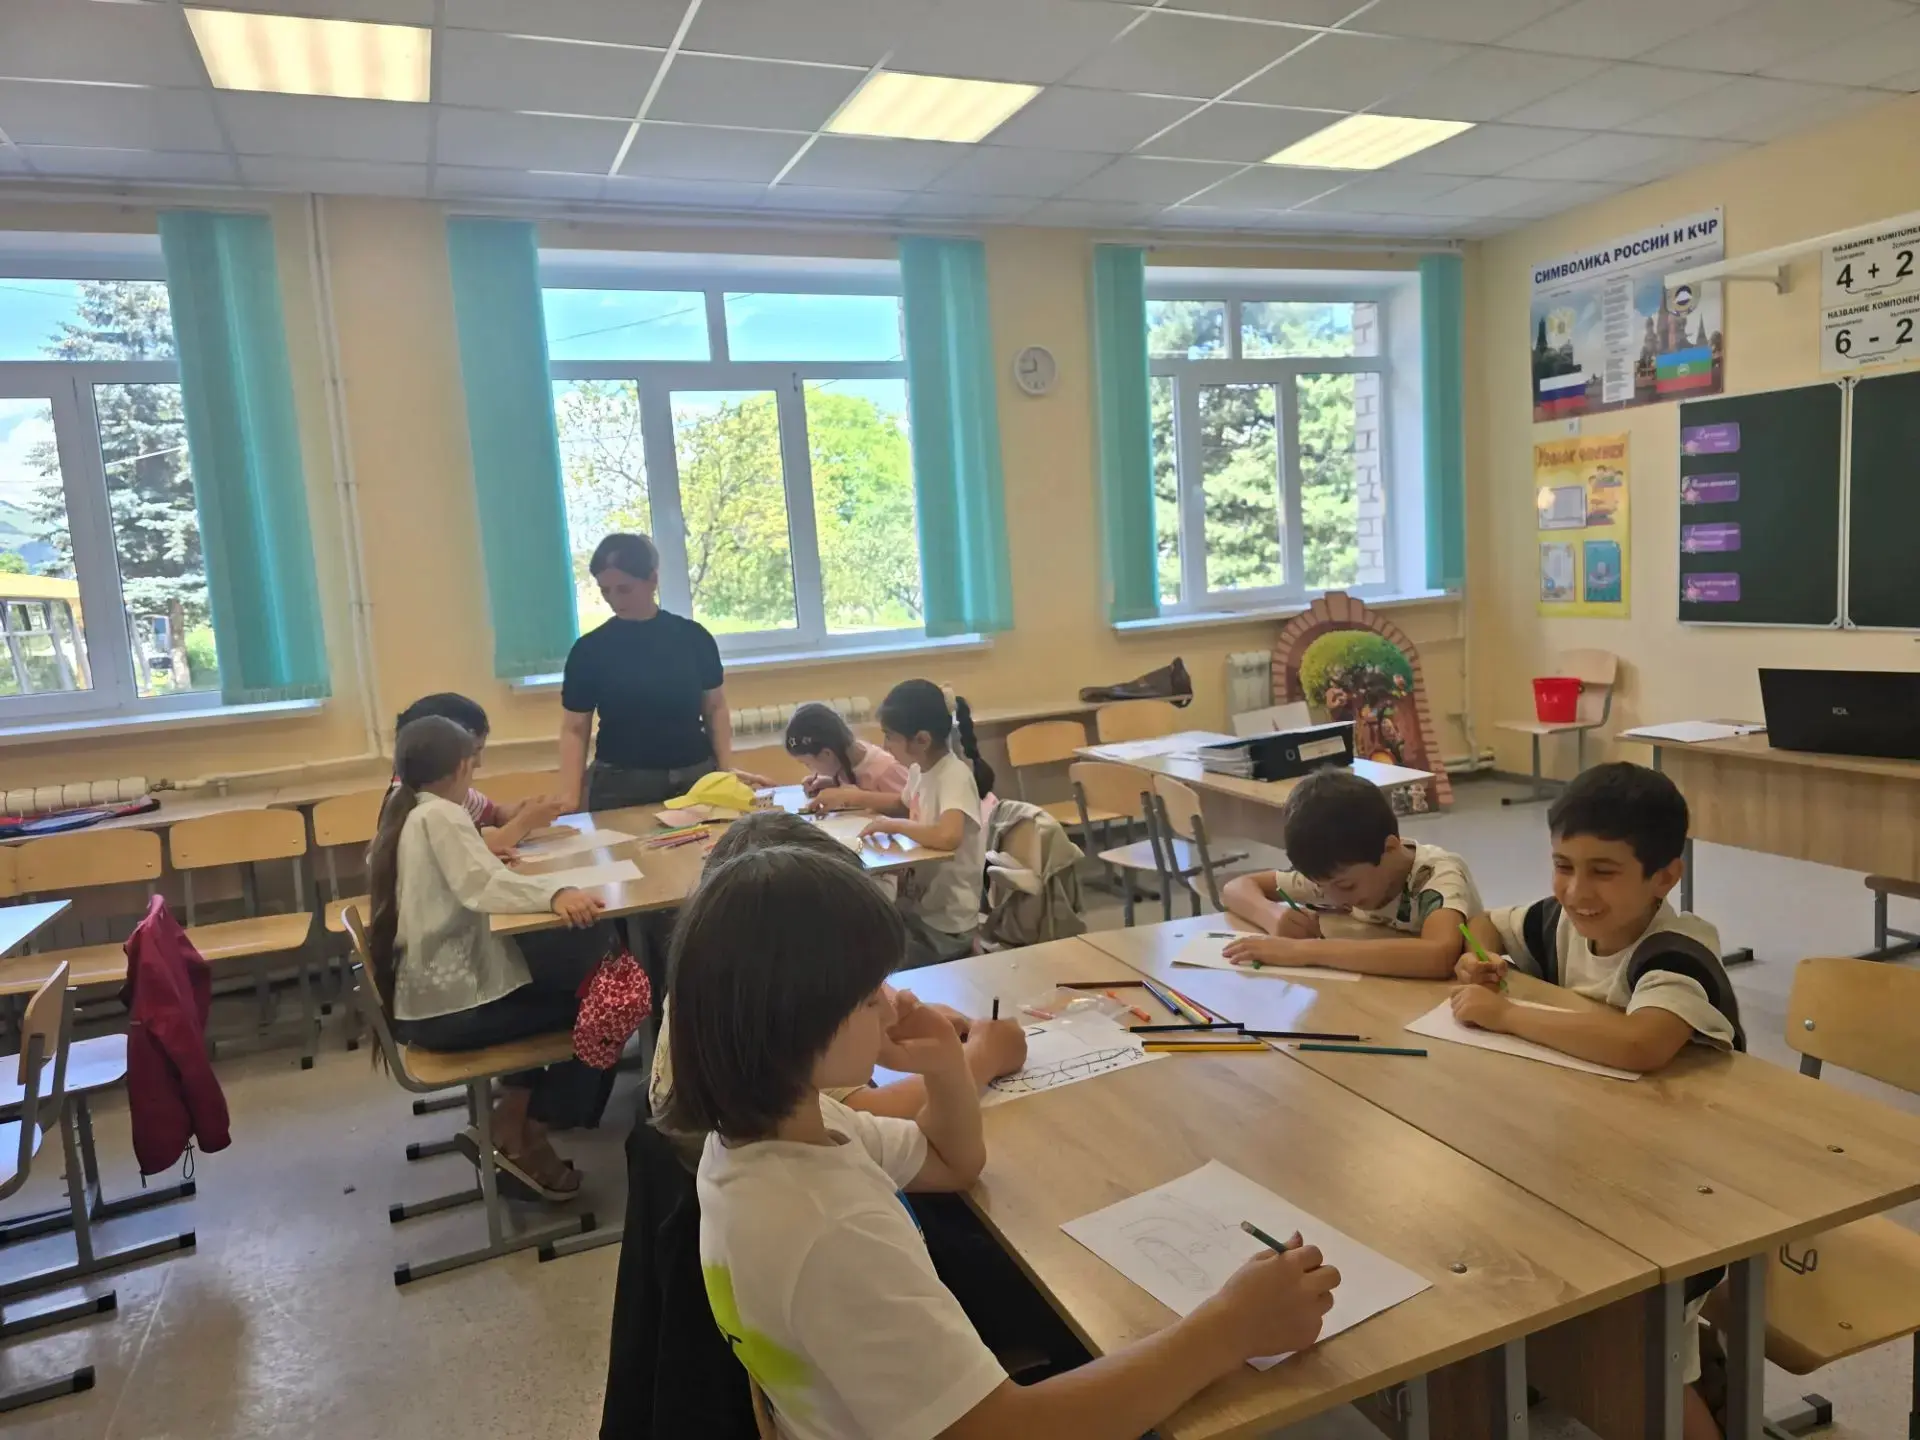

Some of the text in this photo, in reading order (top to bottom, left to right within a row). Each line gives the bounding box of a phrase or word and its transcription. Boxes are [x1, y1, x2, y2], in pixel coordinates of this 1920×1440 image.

[1534, 218, 1718, 285] СИМВОЛИКА РОССИИ И КЧР
[1832, 238, 1875, 253] НАЗВАНИЕ
[1836, 263, 1854, 288] 4
[1868, 262, 1880, 279] +
[1895, 249, 1914, 278] 2
[1828, 304, 1870, 319] НАЗВАНИЕ
[1835, 329, 1852, 354] 6
[1895, 317, 1914, 345] 2
